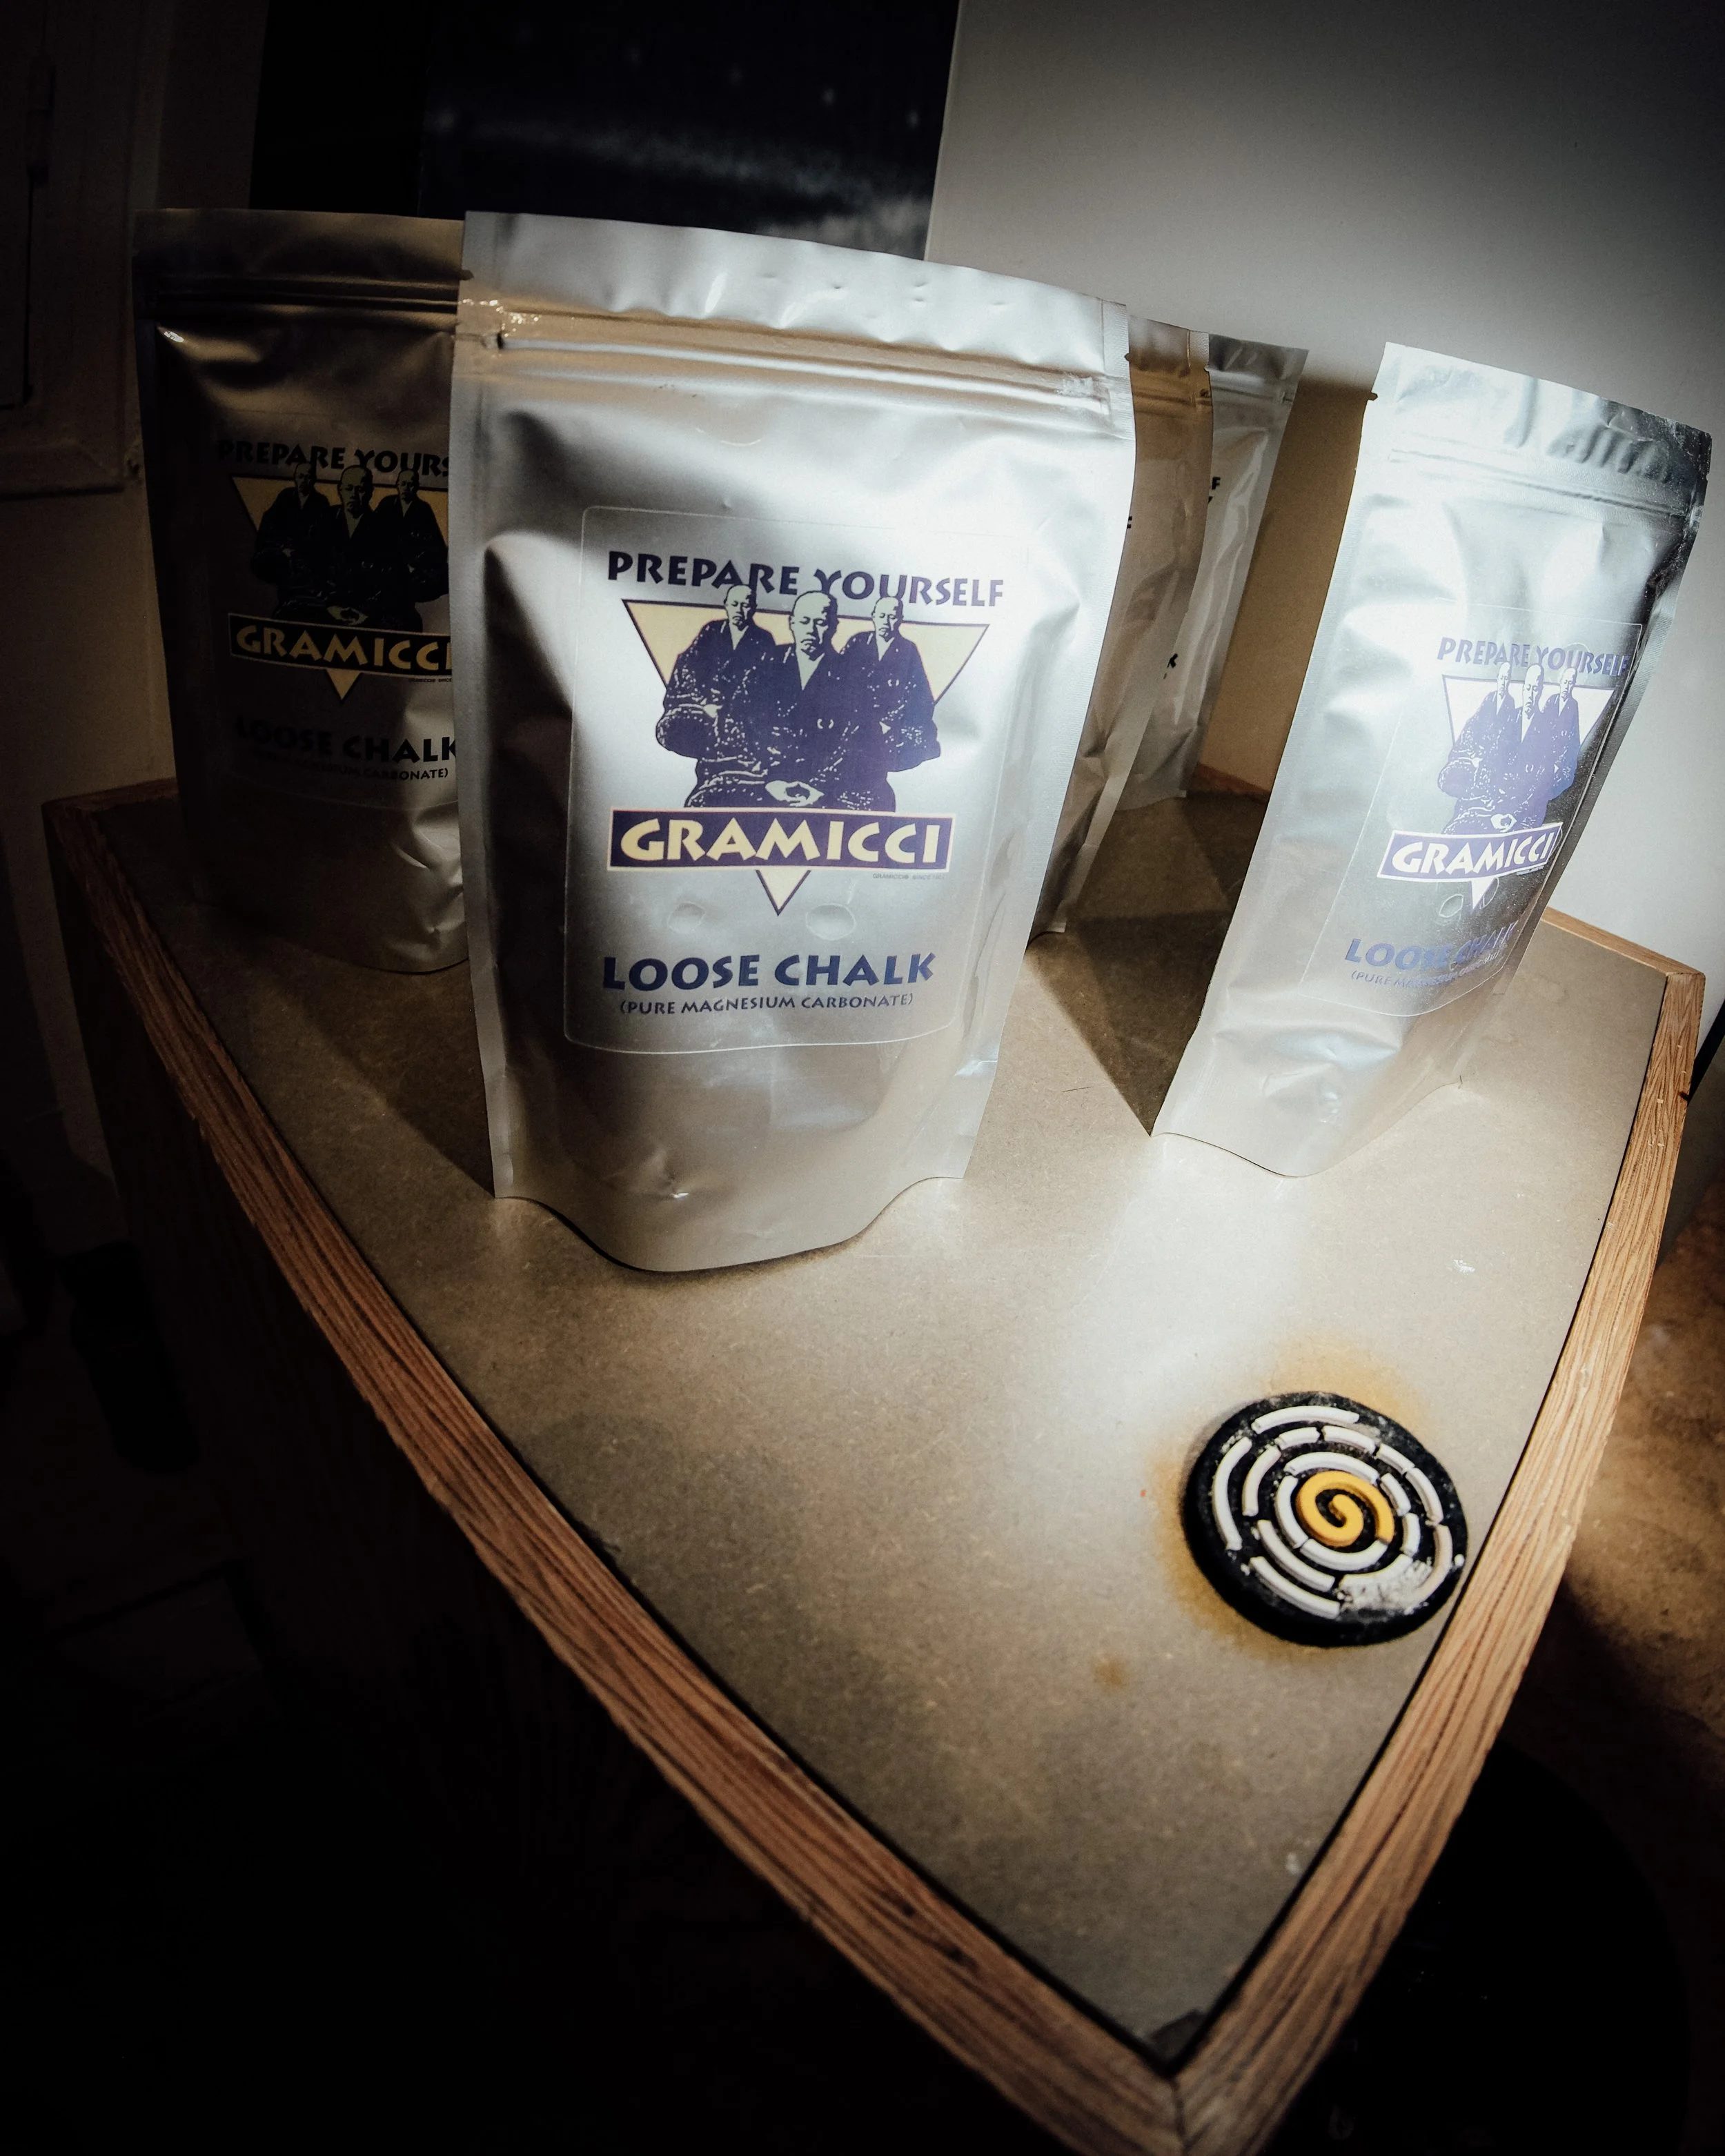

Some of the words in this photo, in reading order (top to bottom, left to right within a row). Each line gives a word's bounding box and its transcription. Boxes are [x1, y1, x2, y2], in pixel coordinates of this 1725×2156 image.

[218, 440, 345, 468] PREPARE
[608, 551, 799, 595] PREPARE
[813, 568, 1004, 608] YOURSELF
[1437, 637, 1530, 667] PREPARE
[1535, 645, 1631, 676] YOURSELF
[236, 715, 332, 754] LOOSE
[343, 735, 455, 763] CHALK
[620, 817, 940, 864] GRAMICCI
[1392, 833, 1552, 874] GRAMICCI
[602, 955, 760, 991] LOOSE
[773, 952, 936, 988] CHALK
[621, 1000, 676, 1016] (PURE
[681, 996, 796, 1013] MAGNESIUM
[801, 993, 913, 1010] CARBONATE)
